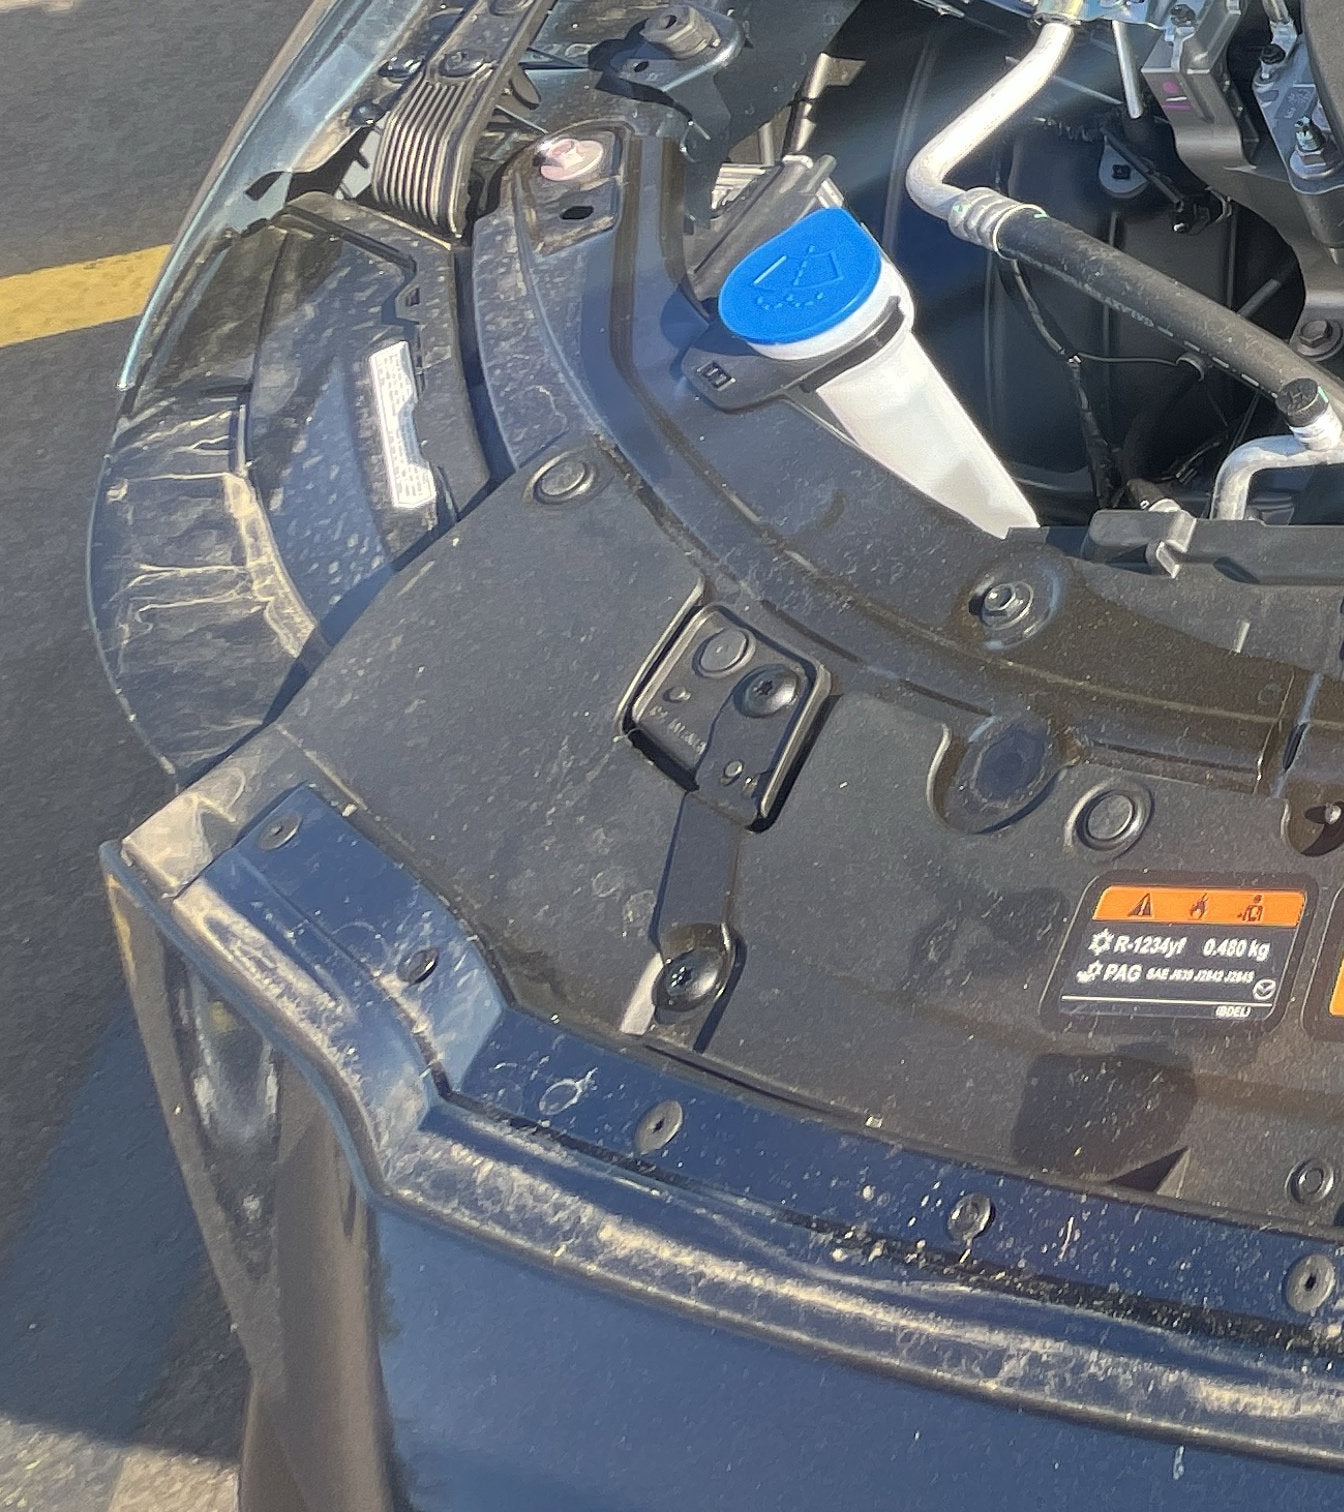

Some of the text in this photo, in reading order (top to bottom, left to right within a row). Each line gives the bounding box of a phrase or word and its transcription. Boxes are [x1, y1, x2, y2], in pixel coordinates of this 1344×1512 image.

[1113, 935, 1271, 962] R-1234yf 0.480 kg
[1103, 963, 1143, 983] PAG
[1145, 967, 1170, 980] SAE
